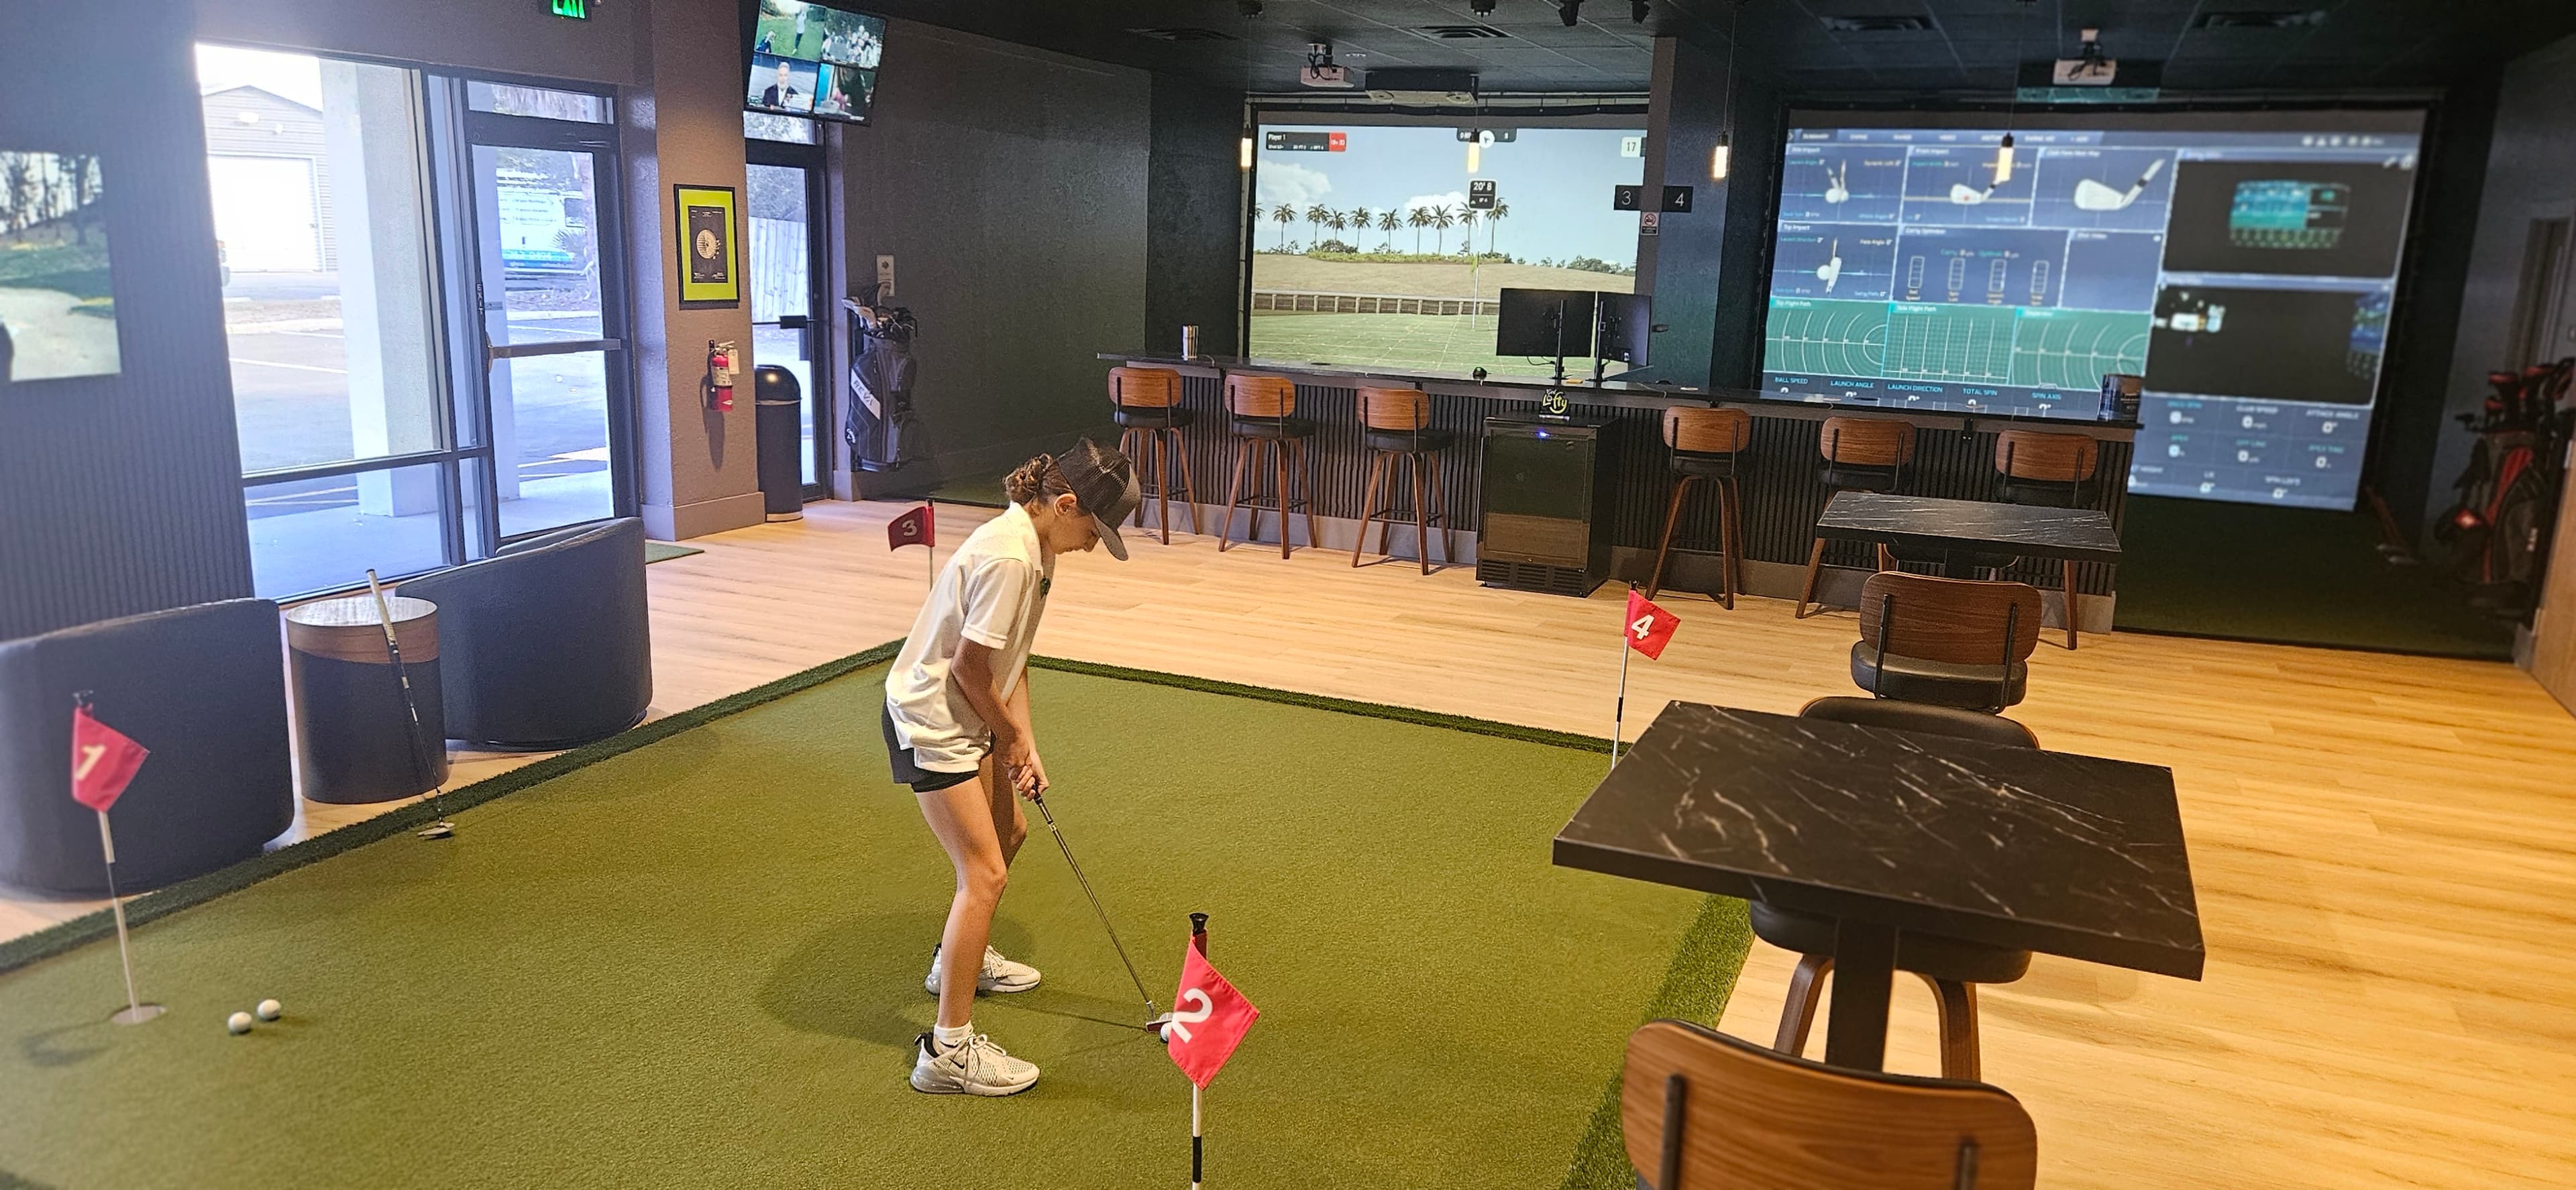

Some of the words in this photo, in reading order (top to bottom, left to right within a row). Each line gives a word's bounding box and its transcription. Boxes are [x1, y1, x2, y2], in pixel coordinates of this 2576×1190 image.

[1627, 142, 1636, 152] 17
[1487, 182, 1492, 191] 8
[1621, 191, 1631, 205] 3
[1674, 193, 1684, 207] 4
[853, 380, 873, 407] REVA
[902, 519, 917, 537] 3
[1631, 614, 1655, 640] 4
[75, 745, 106, 781] 1
[1172, 988, 1213, 1044] 2
